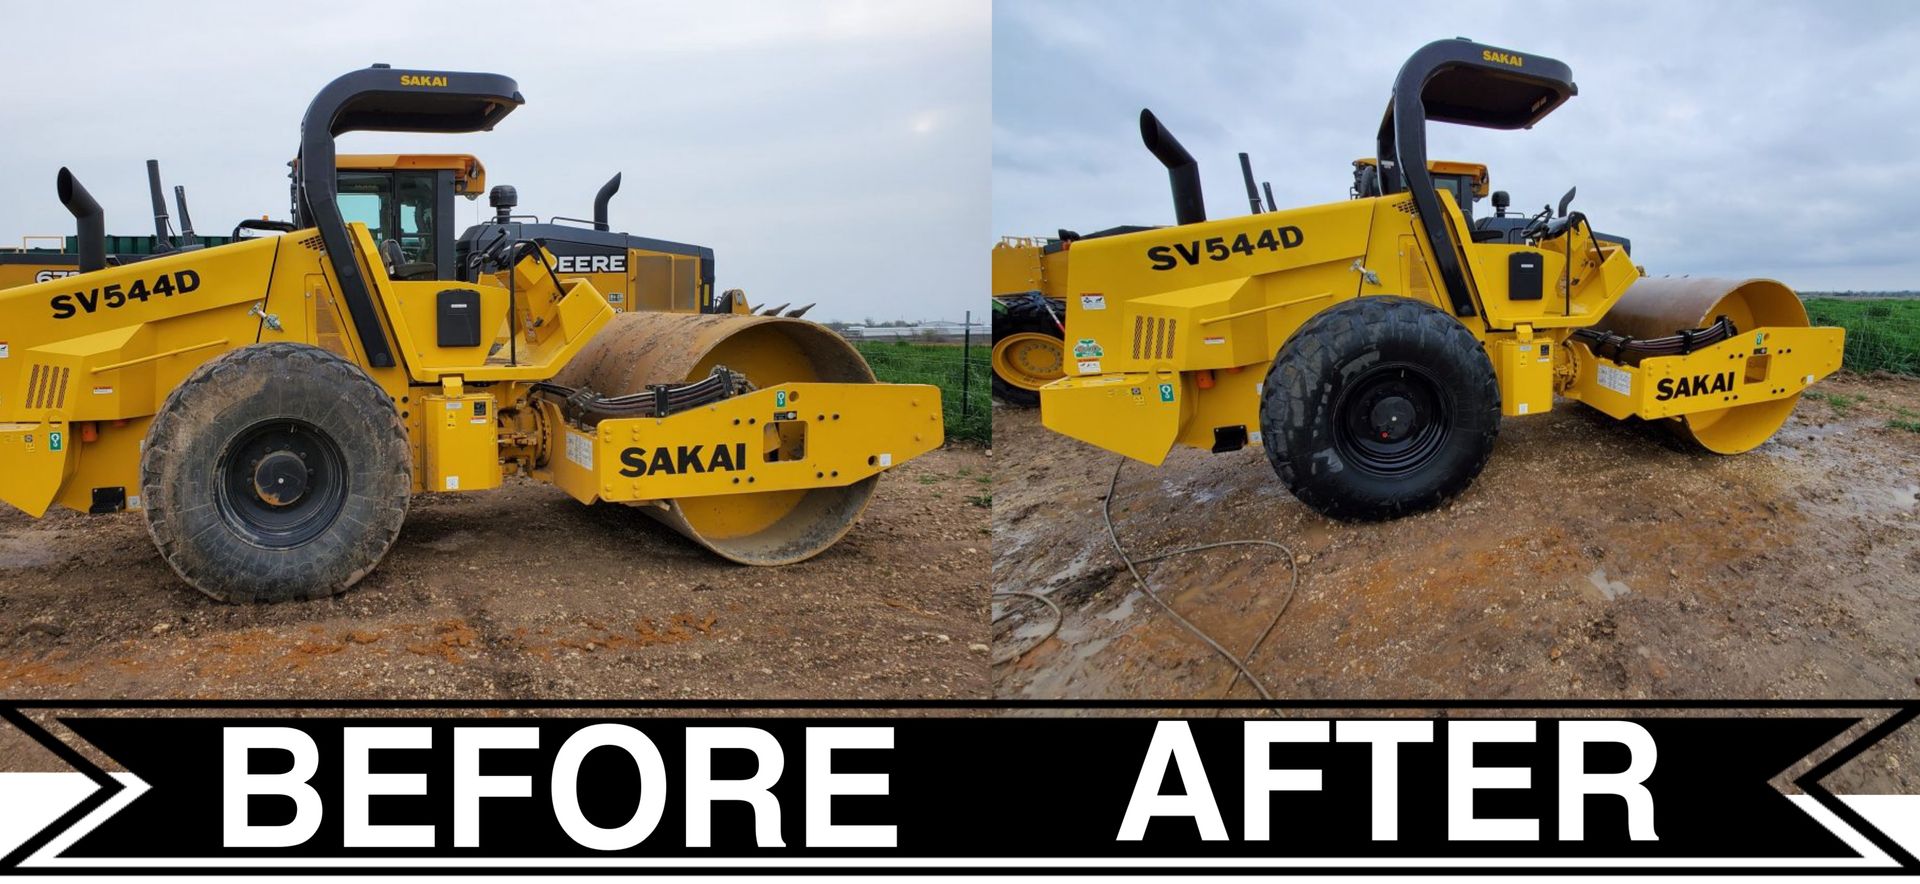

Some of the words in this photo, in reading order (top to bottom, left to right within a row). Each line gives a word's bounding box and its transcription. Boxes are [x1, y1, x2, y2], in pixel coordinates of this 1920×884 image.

[1482, 50, 1523, 67] SAKAI
[400, 74, 448, 87] SAKAI
[1147, 225, 1304, 271] SV544D
[50, 269, 201, 320] SV544D
[1655, 371, 1736, 401] SAKAI
[619, 443, 746, 478] SAKAI
